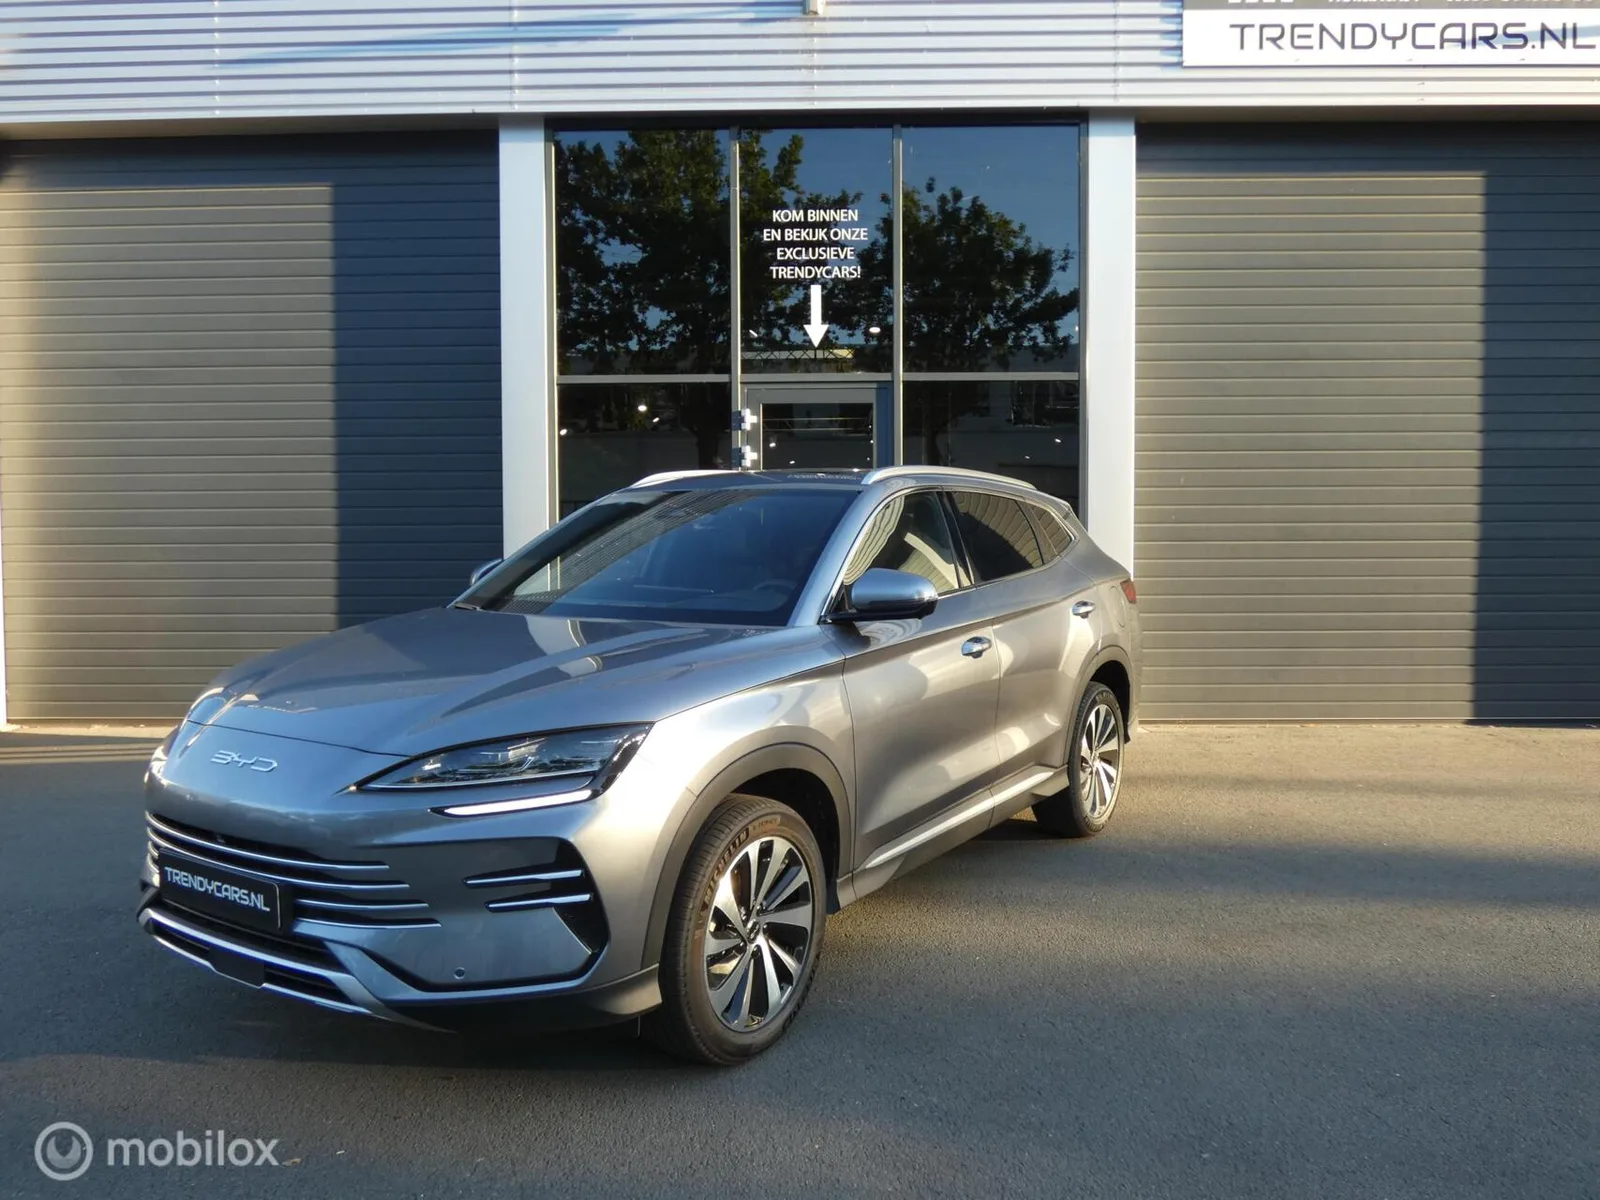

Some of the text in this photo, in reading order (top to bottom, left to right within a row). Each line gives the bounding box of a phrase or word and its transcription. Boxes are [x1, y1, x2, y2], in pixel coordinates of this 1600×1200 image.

[1229, 22, 1597, 50] TRENDYCARS.NL
[772, 209, 858, 222] KOM BINNEN
[763, 228, 868, 241] EN BEKIJK ONZE
[776, 247, 855, 260] EXCLUSIEVE
[770, 266, 862, 279] TRENDYCARS!
[210, 750, 278, 772] BYD
[164, 866, 271, 912] TRENDYCARS.NL
